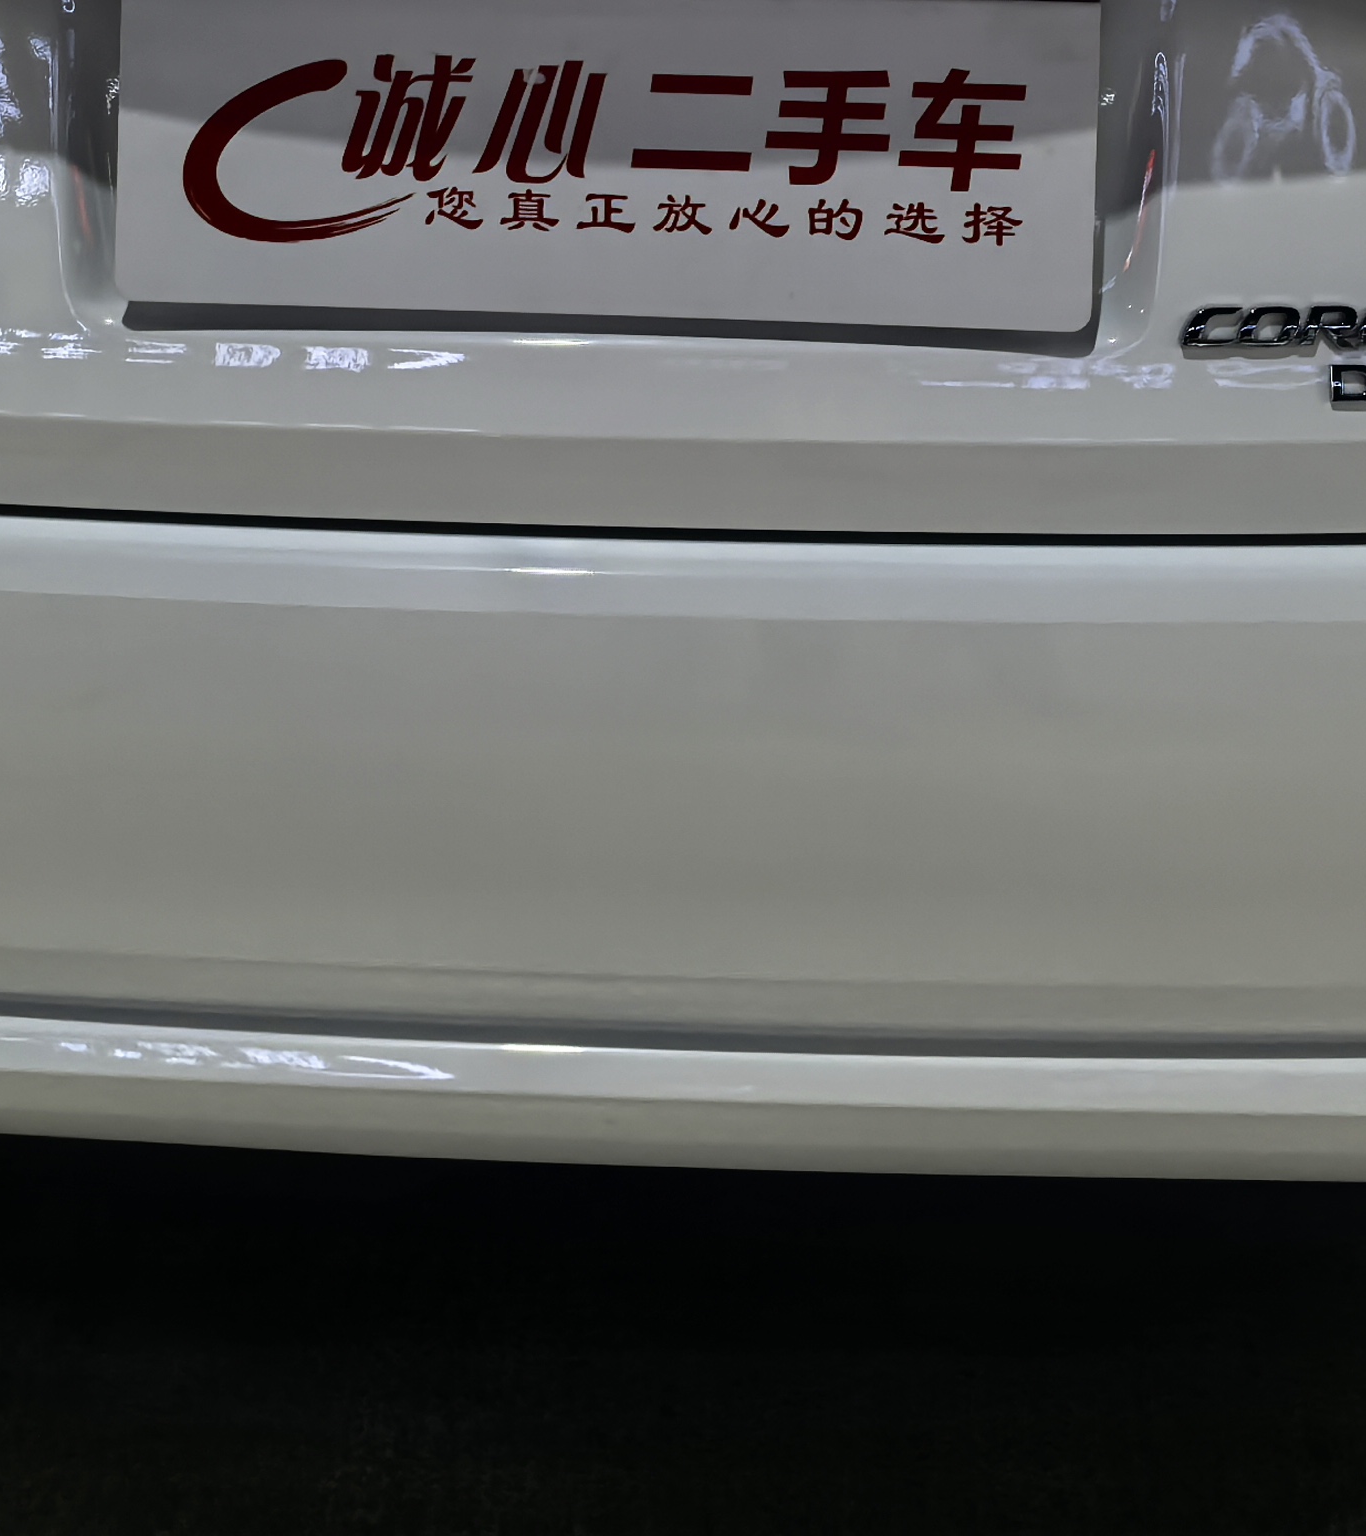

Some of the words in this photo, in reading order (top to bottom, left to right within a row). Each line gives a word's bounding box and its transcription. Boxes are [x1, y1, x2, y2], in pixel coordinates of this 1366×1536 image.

[340, 53, 1028, 193] 诚心二手车
[425, 188, 1024, 248] 您真正放心的选择
